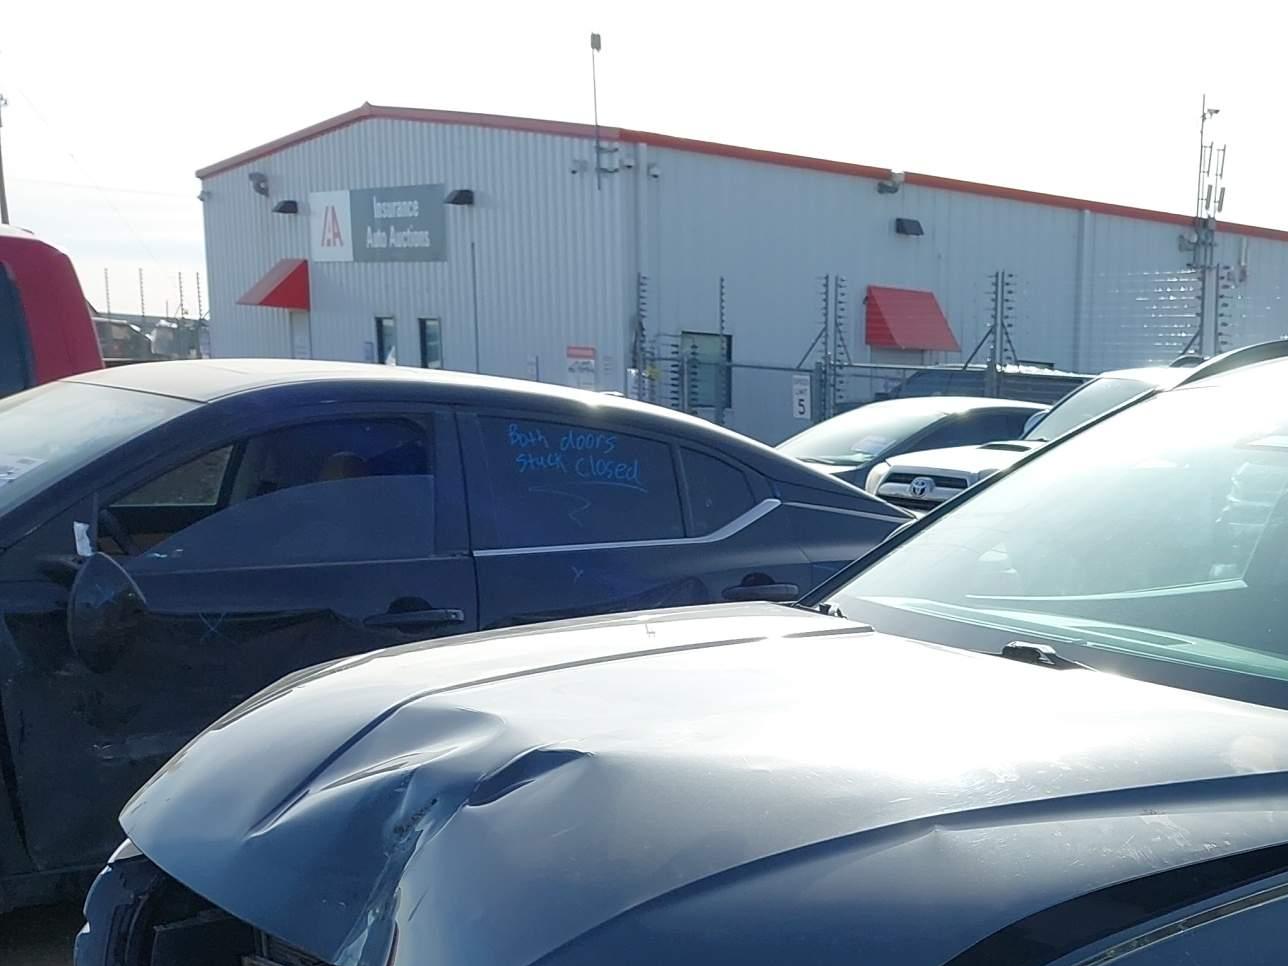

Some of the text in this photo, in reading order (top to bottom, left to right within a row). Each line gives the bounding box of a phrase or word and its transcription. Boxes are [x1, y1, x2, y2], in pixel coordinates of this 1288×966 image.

[373, 195, 419, 218] Insurance
[366, 224, 431, 248] Auto Auctions
[798, 398, 806, 415] 5
[560, 429, 617, 454] doors
